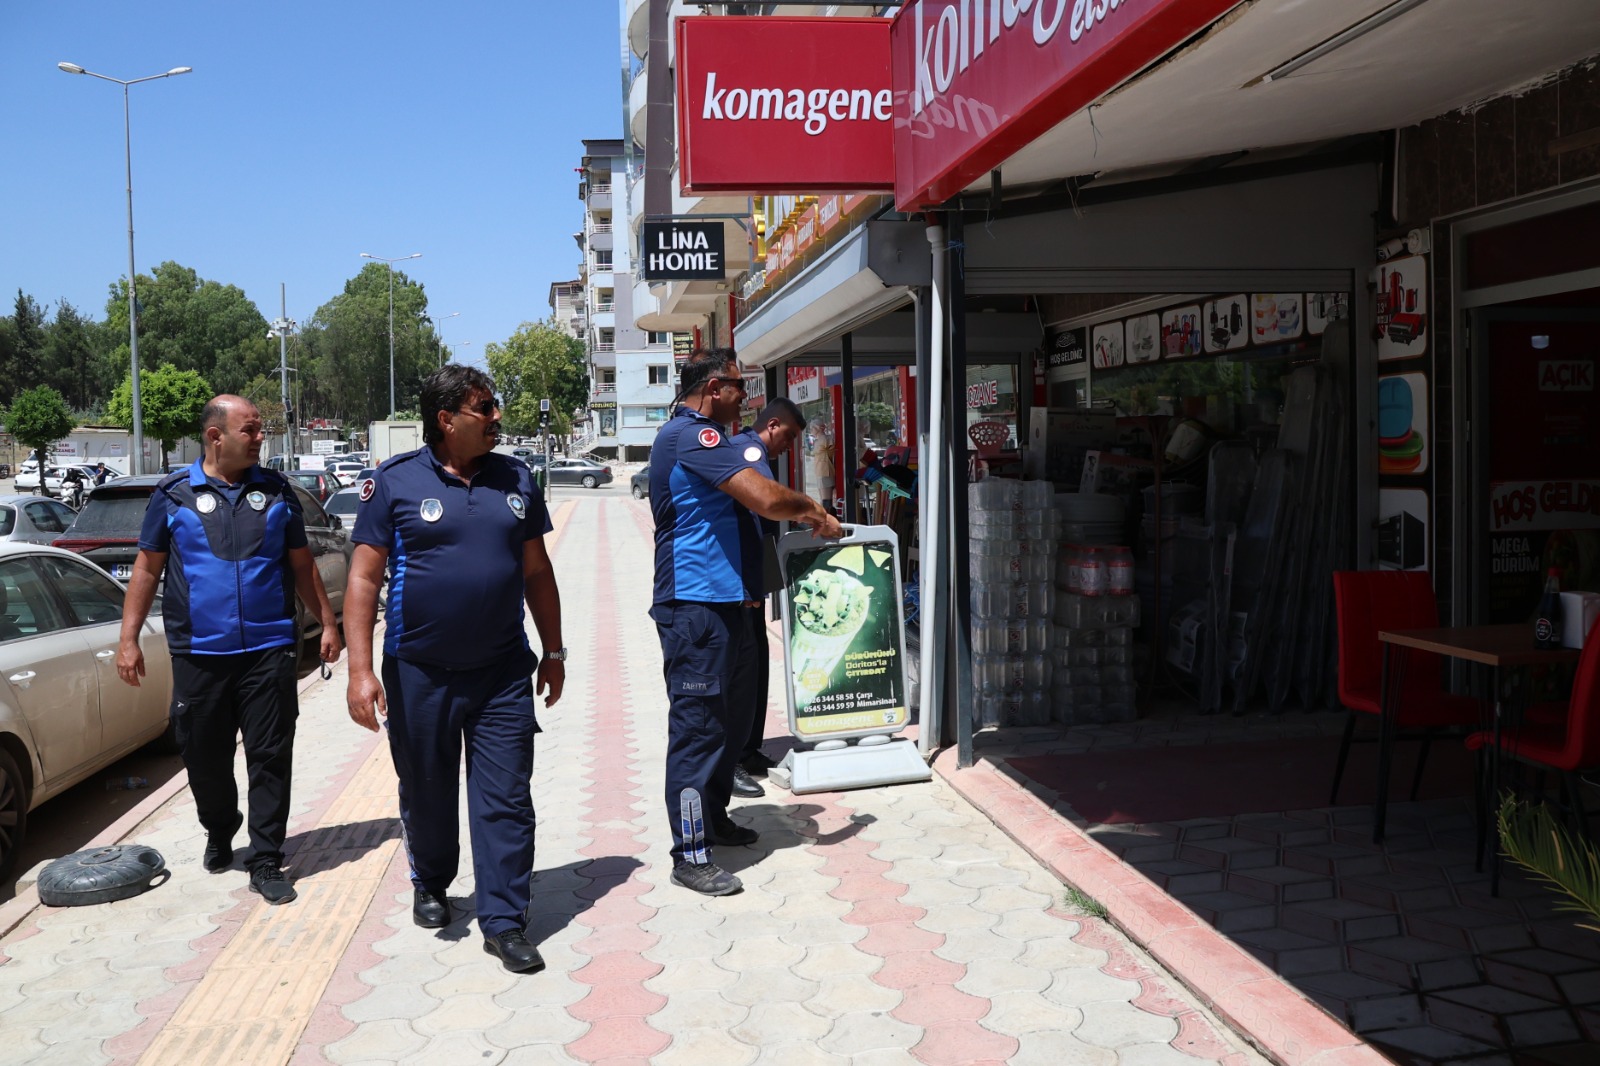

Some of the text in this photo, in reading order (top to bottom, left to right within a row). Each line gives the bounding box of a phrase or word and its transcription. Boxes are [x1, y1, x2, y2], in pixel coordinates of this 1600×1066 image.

[702, 72, 893, 135] komagene
[658, 227, 709, 249] LİNA
[649, 252, 719, 271] HOME
[1050, 353, 1061, 365] HOŞ
[1542, 364, 1591, 390] AÇIK
[967, 380, 998, 408] CZANE
[1493, 486, 1536, 528] HOŞ
[1491, 537, 1531, 555] MEGA
[1491, 553, 1540, 574] DÜRÜM
[845, 648, 896, 661] DÜRÜMÜNÜ
[846, 659, 887, 669] Doritos'la
[856, 692, 873, 700] Çarşı
[803, 705, 821, 713] 0545
[856, 698, 897, 708] Mimarsinan
[887, 715, 894, 723] 2
